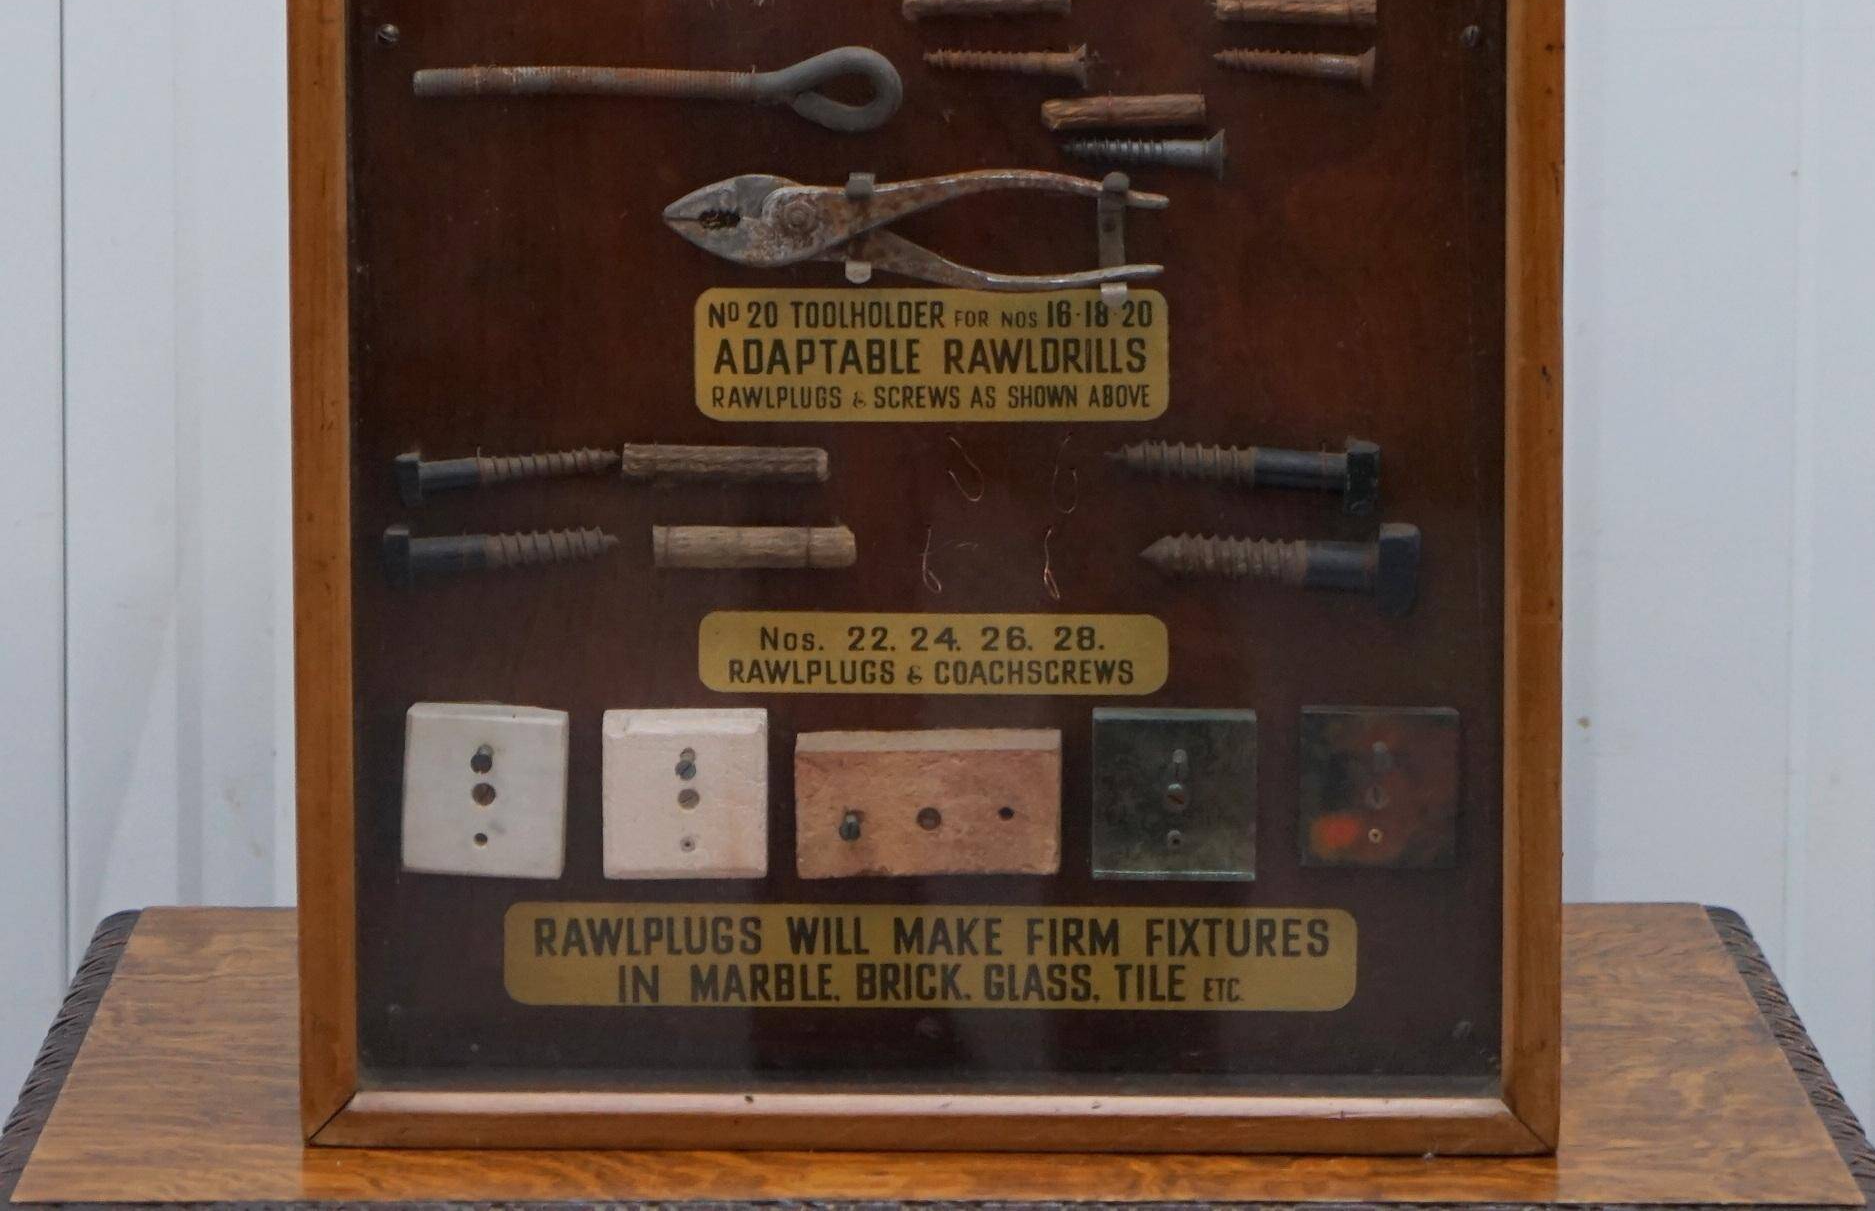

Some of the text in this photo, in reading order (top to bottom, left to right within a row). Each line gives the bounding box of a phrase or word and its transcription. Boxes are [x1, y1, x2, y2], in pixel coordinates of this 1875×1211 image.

[748, 301, 777, 328] 20
[790, 301, 944, 328] TOOLHOLDER
[955, 310, 988, 327] FOR
[1002, 311, 1037, 328] NOS
[714, 338, 1146, 374] ADAPTABLE RAWLDRILLS
[713, 385, 1149, 409] RAWLPLUGS & SCREWS AS SHOWN ABOVE
[848, 627, 895, 651] 22.
[911, 627, 960, 651] 24.
[982, 627, 1032, 651] 26.
[1055, 627, 1104, 651] 28.
[729, 660, 1133, 685] RAWLPLUGS & COACHSCREWS
[534, 916, 1328, 957] RAWLPLUGS WILL MAKE FIRM FIXTURES
[619, 965, 659, 1003] IN
[1115, 964, 1185, 1001] TILE
